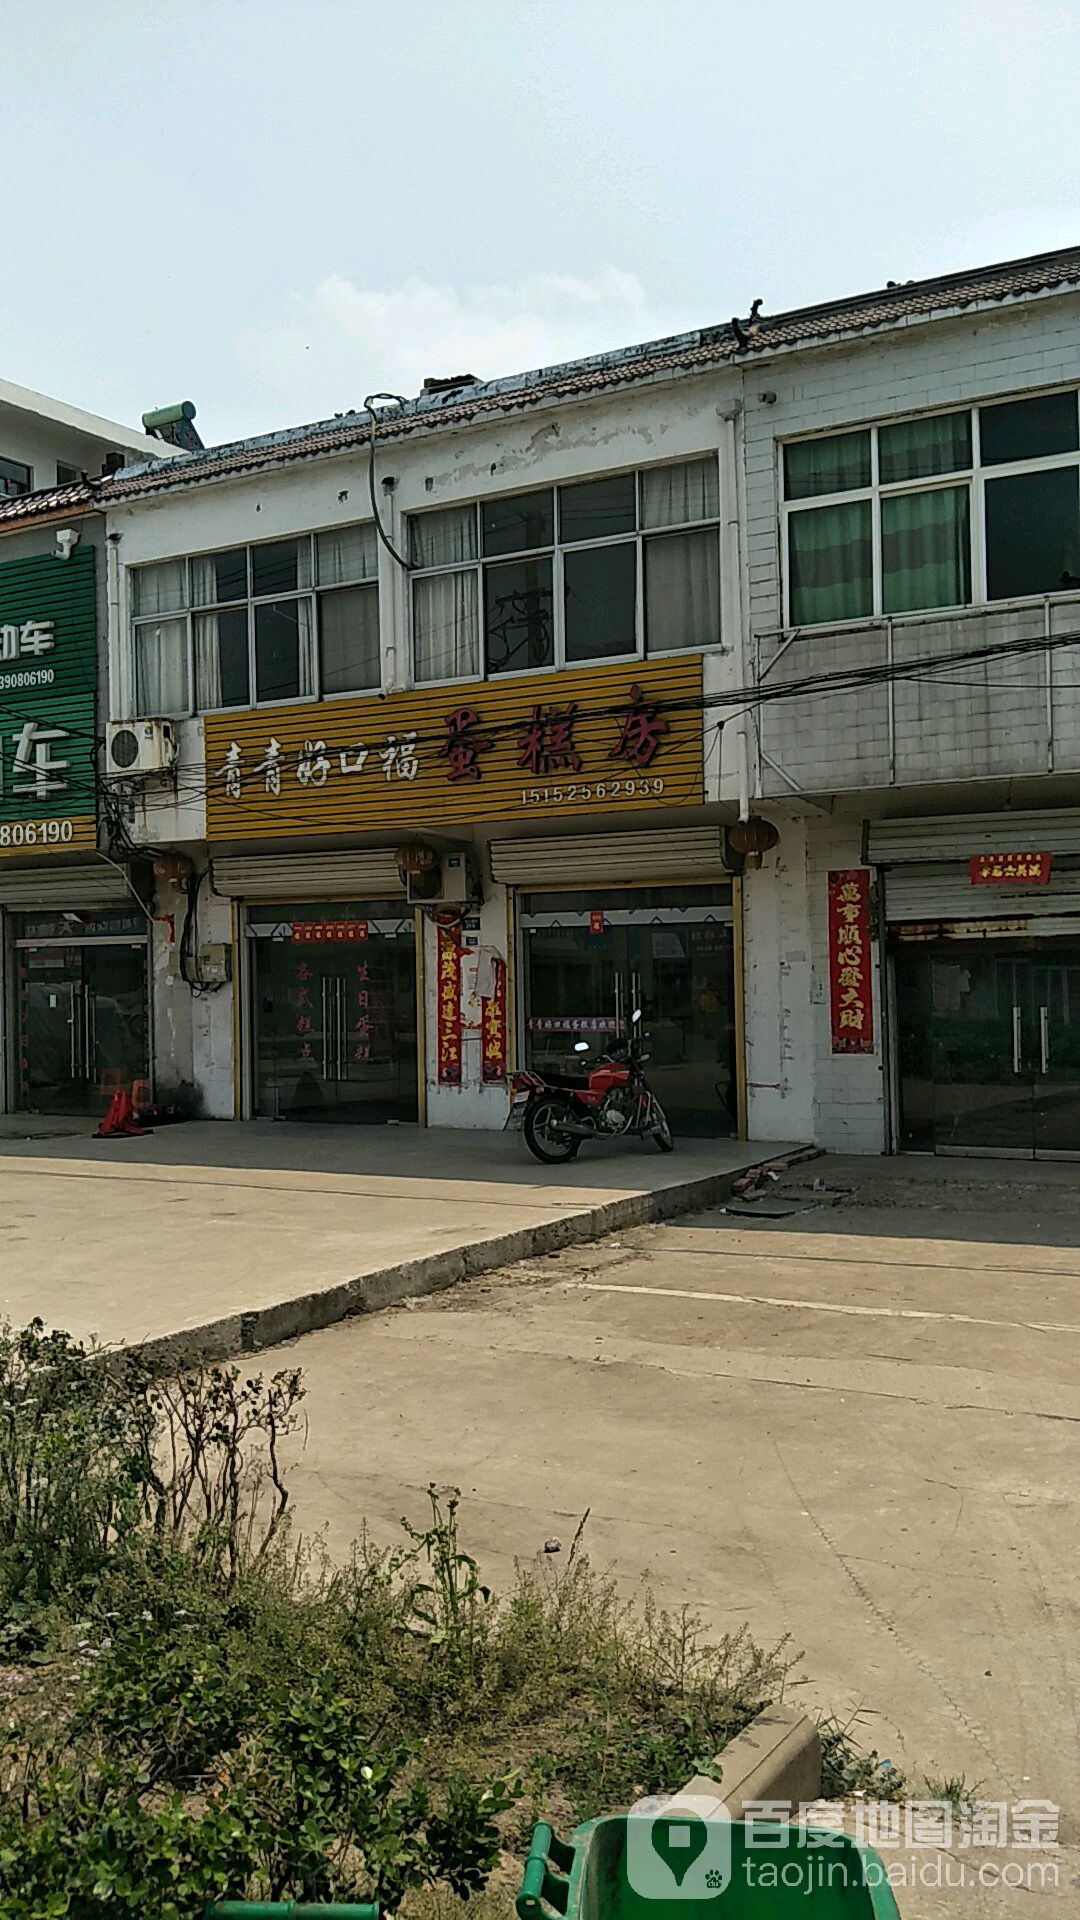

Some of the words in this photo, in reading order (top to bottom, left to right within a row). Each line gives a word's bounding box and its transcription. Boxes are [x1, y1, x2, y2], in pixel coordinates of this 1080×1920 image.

[0, 669, 54, 690] 390806190
[439, 684, 668, 781] 蛋糕房
[0, 722, 71, 800] 车
[520, 778, 665, 805] 15152562939
[0, 819, 73, 847] 806190
